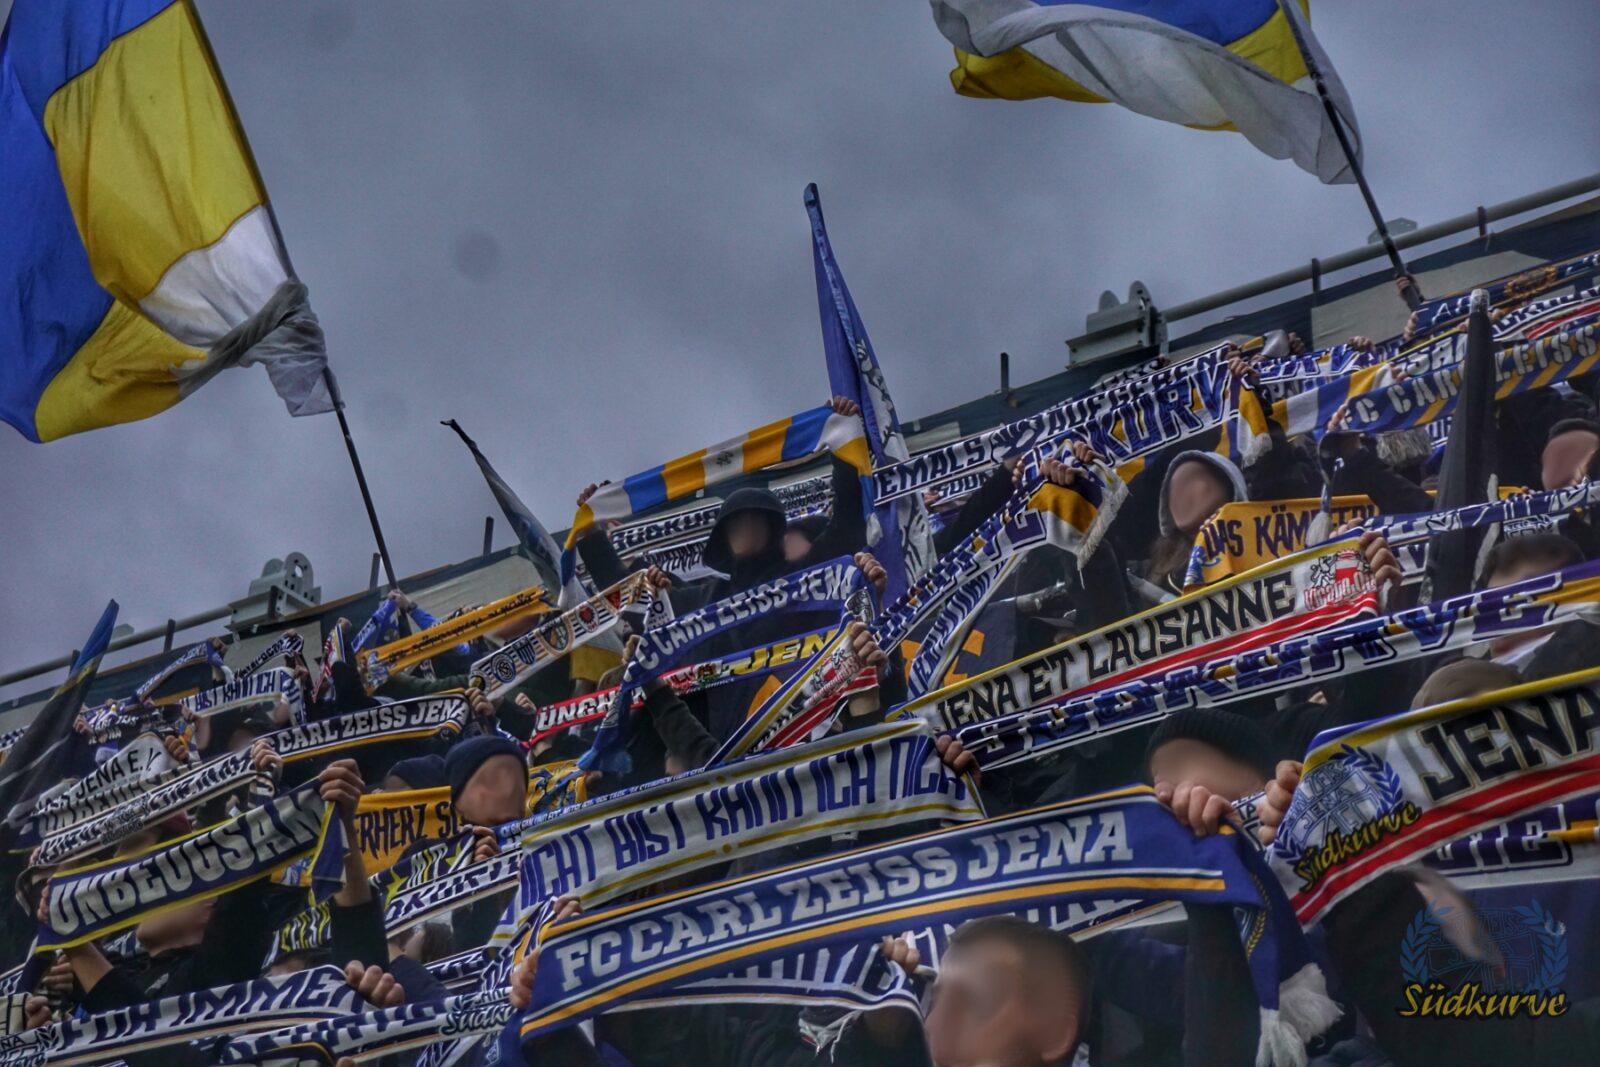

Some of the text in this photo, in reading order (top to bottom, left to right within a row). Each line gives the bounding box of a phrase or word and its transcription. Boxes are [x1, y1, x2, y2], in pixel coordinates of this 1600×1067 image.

[1086, 361, 1229, 467] KURV
[1387, 362, 1465, 414] CAR
[872, 436, 986, 499] IEMALS
[613, 508, 721, 552] SÜDKUR
[653, 613, 715, 655] CARL
[717, 579, 788, 627] ZEISS
[792, 564, 859, 601] JENA
[730, 629, 838, 676] JEN
[934, 675, 1020, 731] JENA
[1021, 652, 1075, 692] ET
[1081, 572, 1295, 679] LAUSANNE
[279, 722, 339, 752] CARL
[342, 709, 408, 738] ZEISS
[410, 700, 469, 728] JENA
[1416, 687, 1600, 801] JENA
[75, 760, 124, 798] JENA
[606, 801, 686, 869] BIST
[809, 743, 876, 812] ICH
[890, 735, 965, 800] NICH
[50, 788, 324, 935] UNBEUGSAM
[354, 803, 427, 859] ERHERZ
[1295, 801, 1421, 892] Südkurve
[557, 810, 1133, 990] FC CARL ZEISS JENA
[169, 968, 335, 1028] IMME
